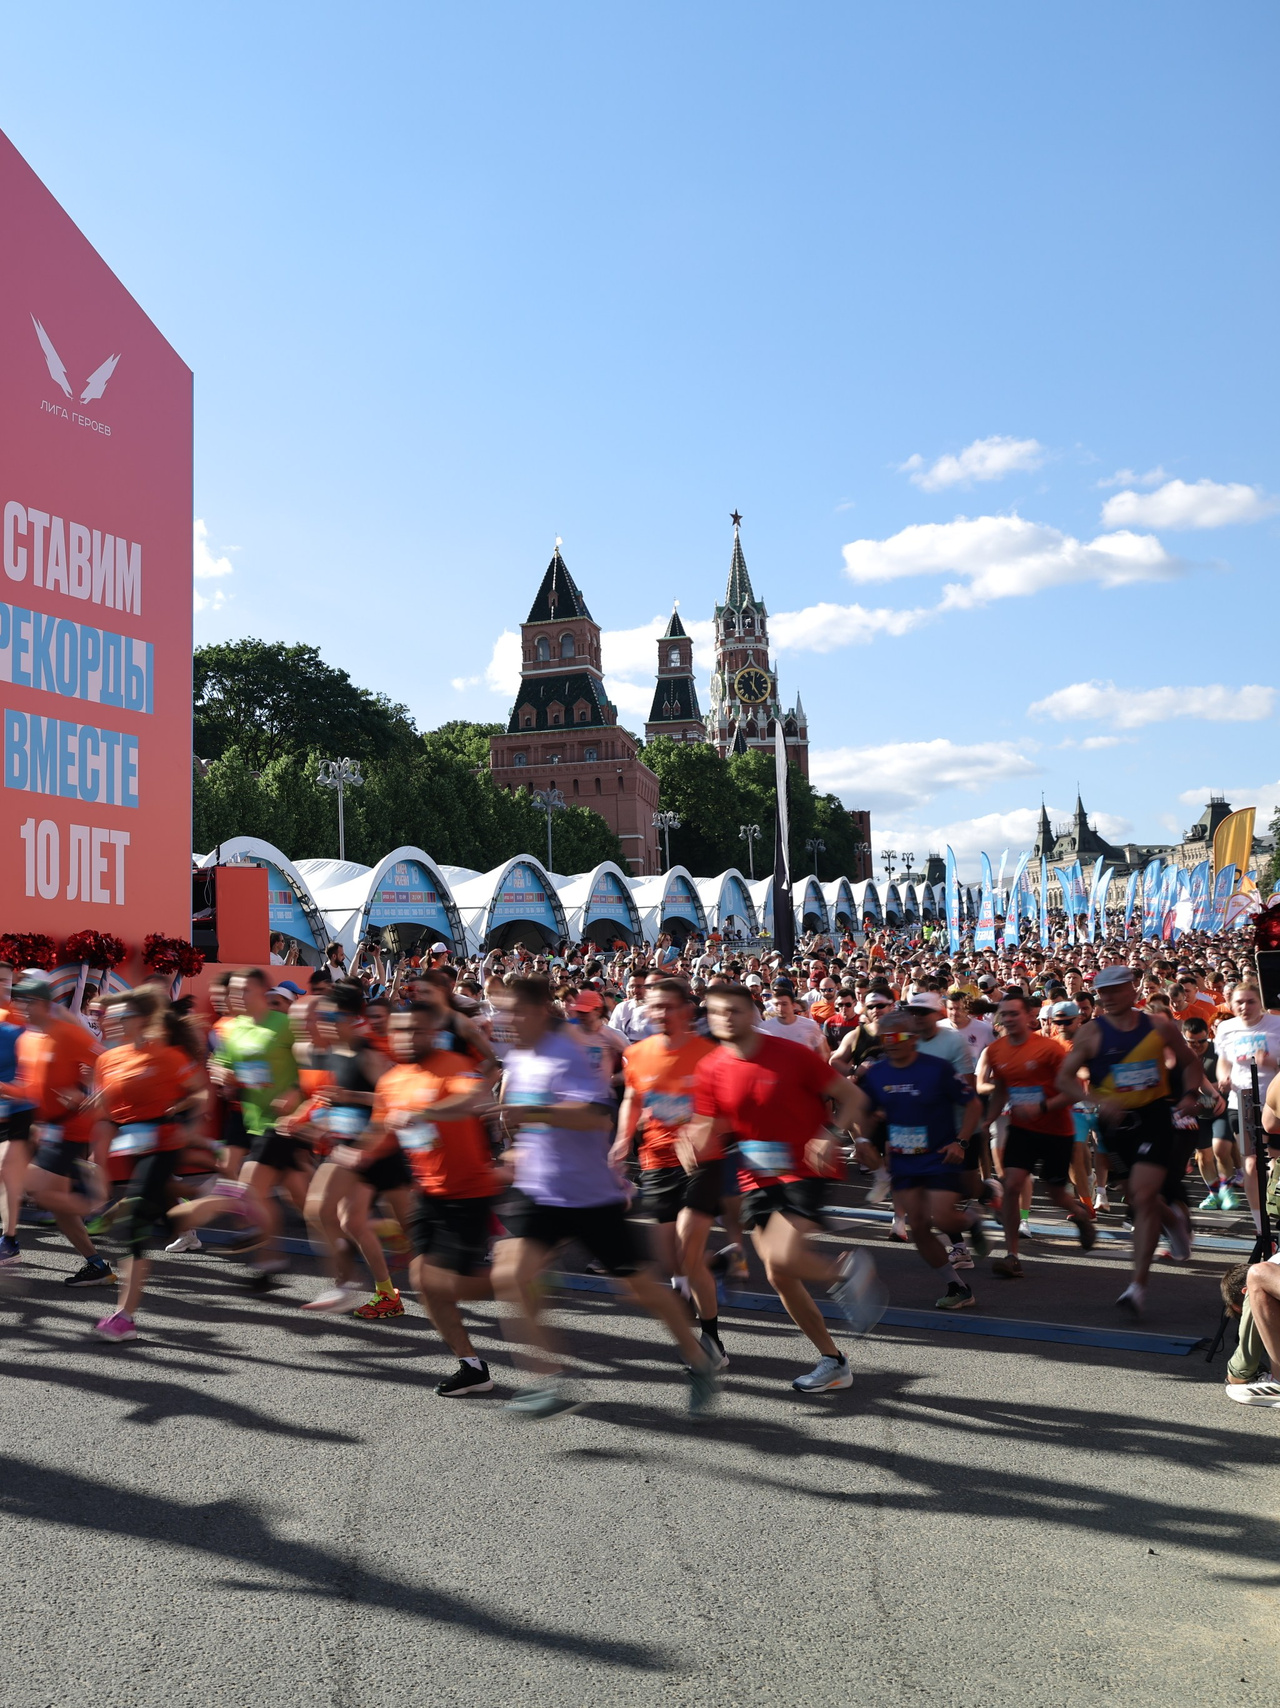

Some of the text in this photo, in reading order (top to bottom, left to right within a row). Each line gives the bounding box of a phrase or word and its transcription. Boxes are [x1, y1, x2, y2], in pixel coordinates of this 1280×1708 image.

[40, 400, 112, 436] ЛИГА ГЕРОЕВ
[3, 500, 142, 616] СТАВИМ
[4, 708, 139, 808] ВМЕСТЕ
[20, 817, 131, 906] 10 ЛЕТ
